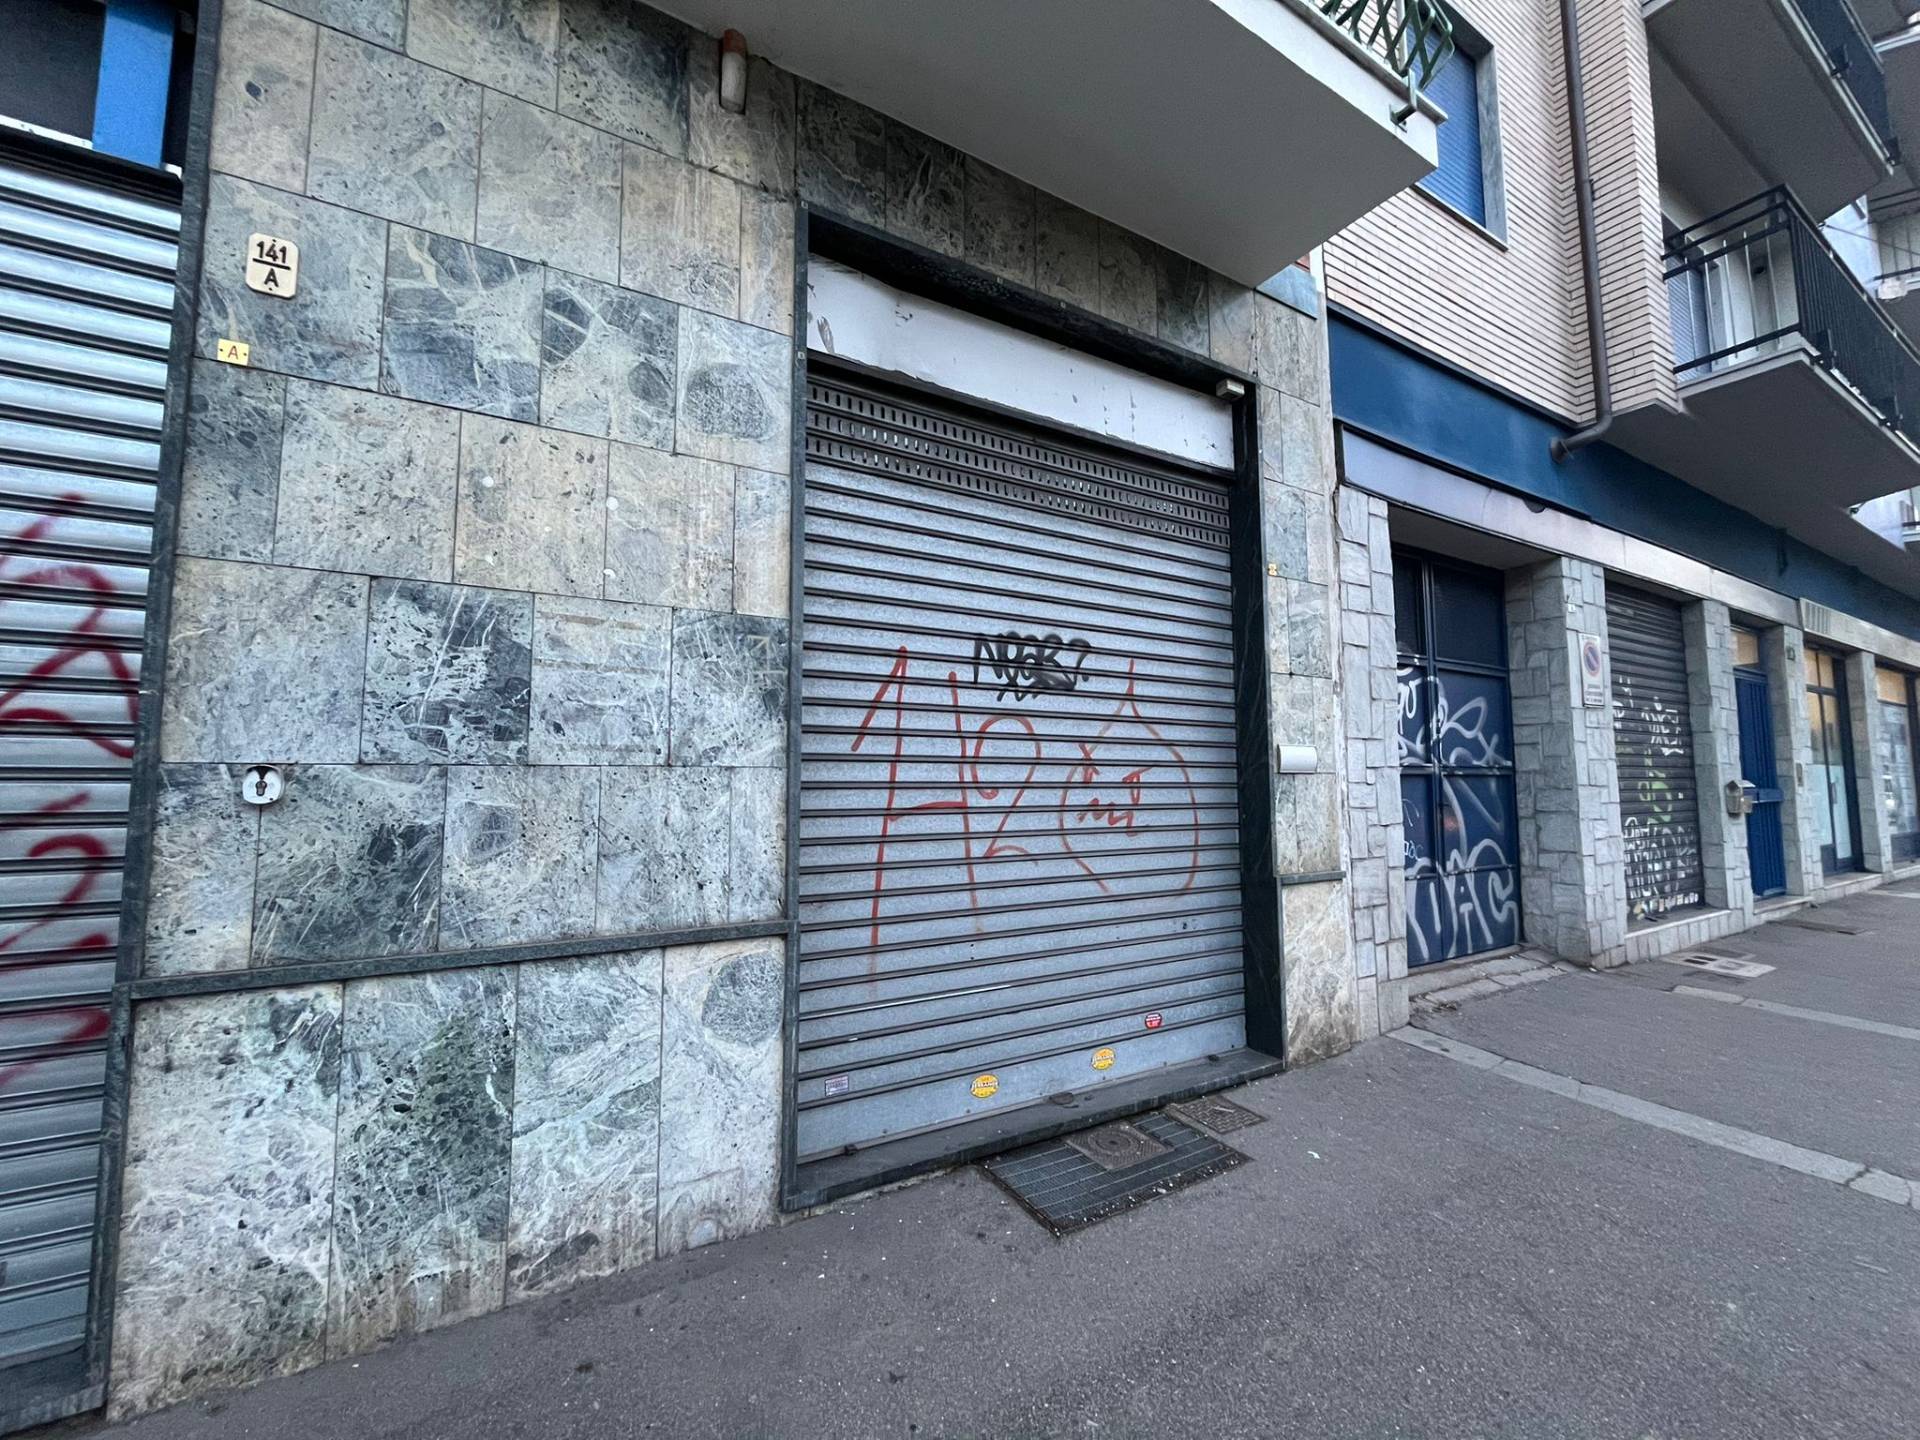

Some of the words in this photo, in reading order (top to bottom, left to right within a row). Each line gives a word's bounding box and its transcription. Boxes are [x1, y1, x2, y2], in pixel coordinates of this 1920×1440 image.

[256, 240, 288, 264] 141
[264, 267, 279, 288] A
[227, 345, 239, 360] A
